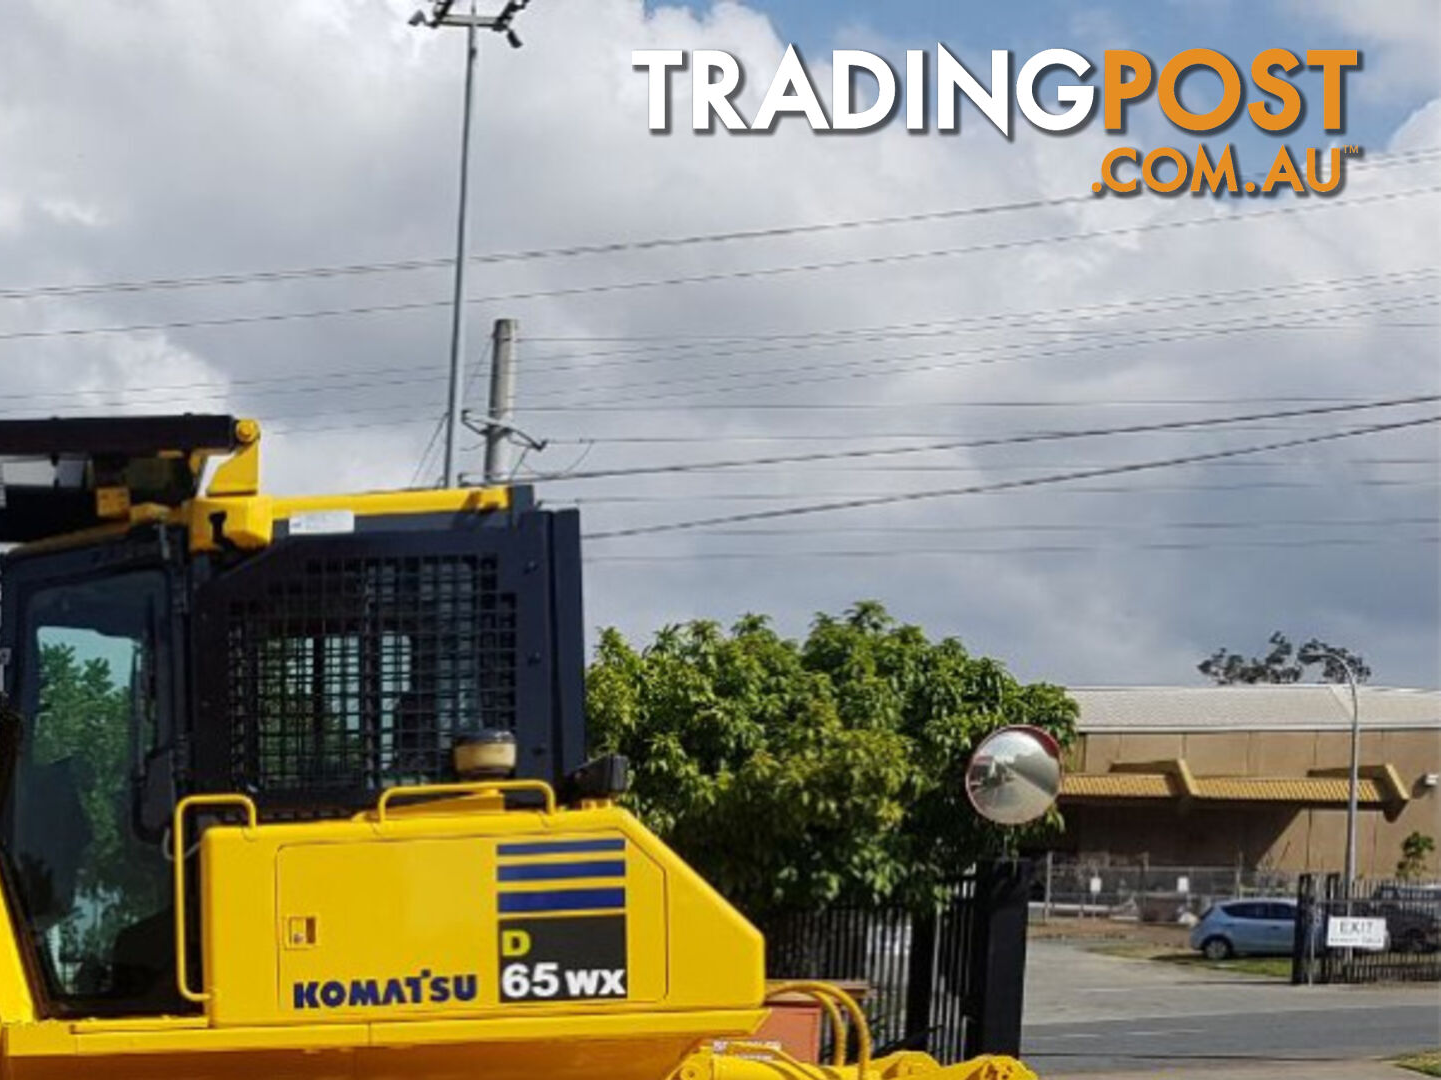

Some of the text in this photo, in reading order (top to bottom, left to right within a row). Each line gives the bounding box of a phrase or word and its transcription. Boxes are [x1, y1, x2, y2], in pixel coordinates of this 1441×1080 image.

[1339, 921, 1374, 934] EXIT
[502, 930, 532, 957] D
[293, 968, 477, 1009] KOMATSU
[501, 962, 626, 998] 65 WX
